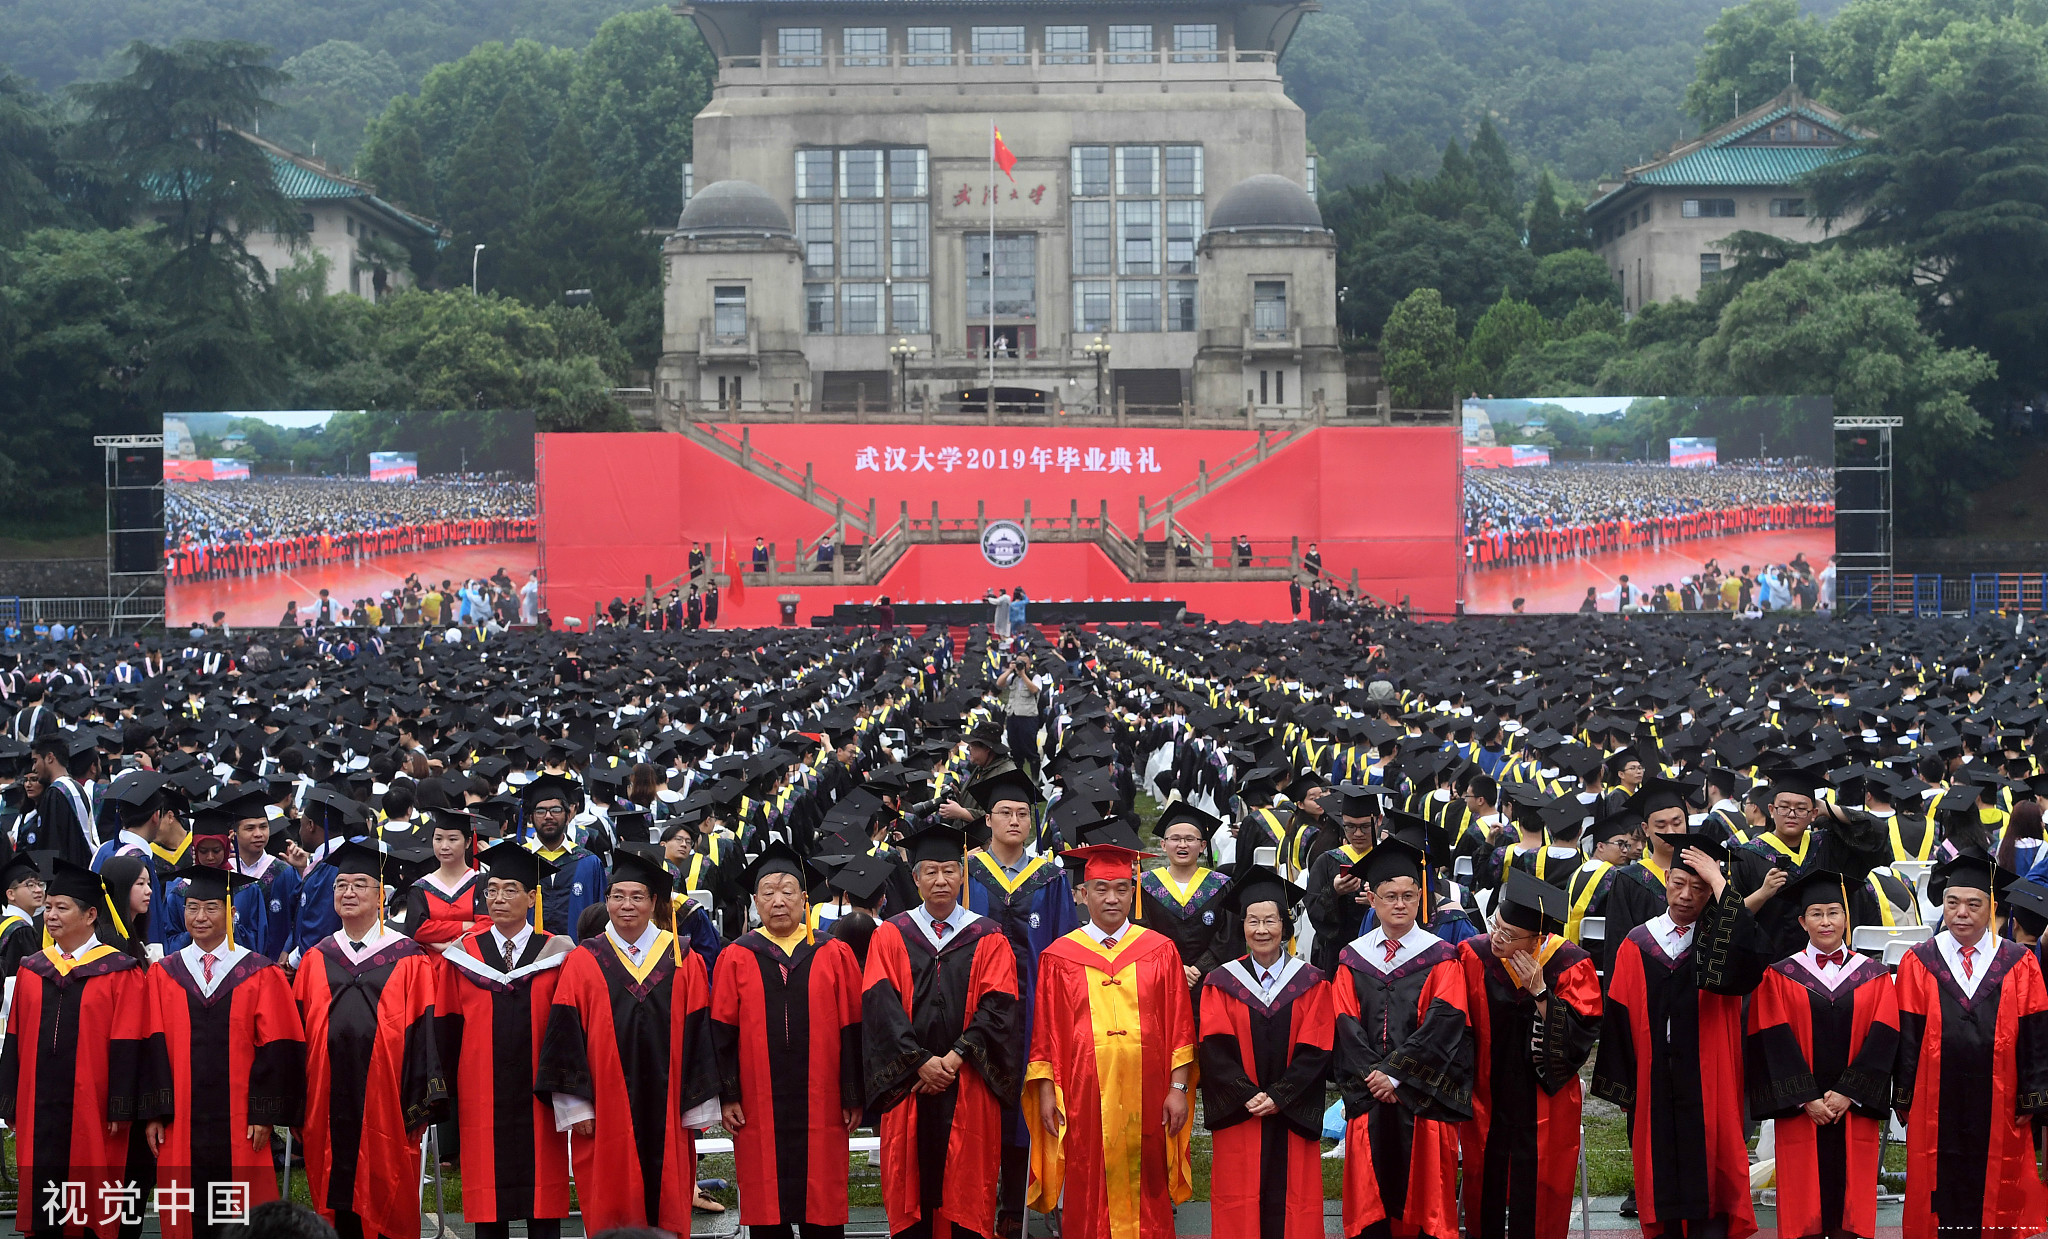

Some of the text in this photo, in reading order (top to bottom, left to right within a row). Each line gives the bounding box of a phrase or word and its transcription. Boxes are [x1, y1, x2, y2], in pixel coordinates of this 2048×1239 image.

[854, 445, 1162, 474] 武汉大学2019年毕业典礼
